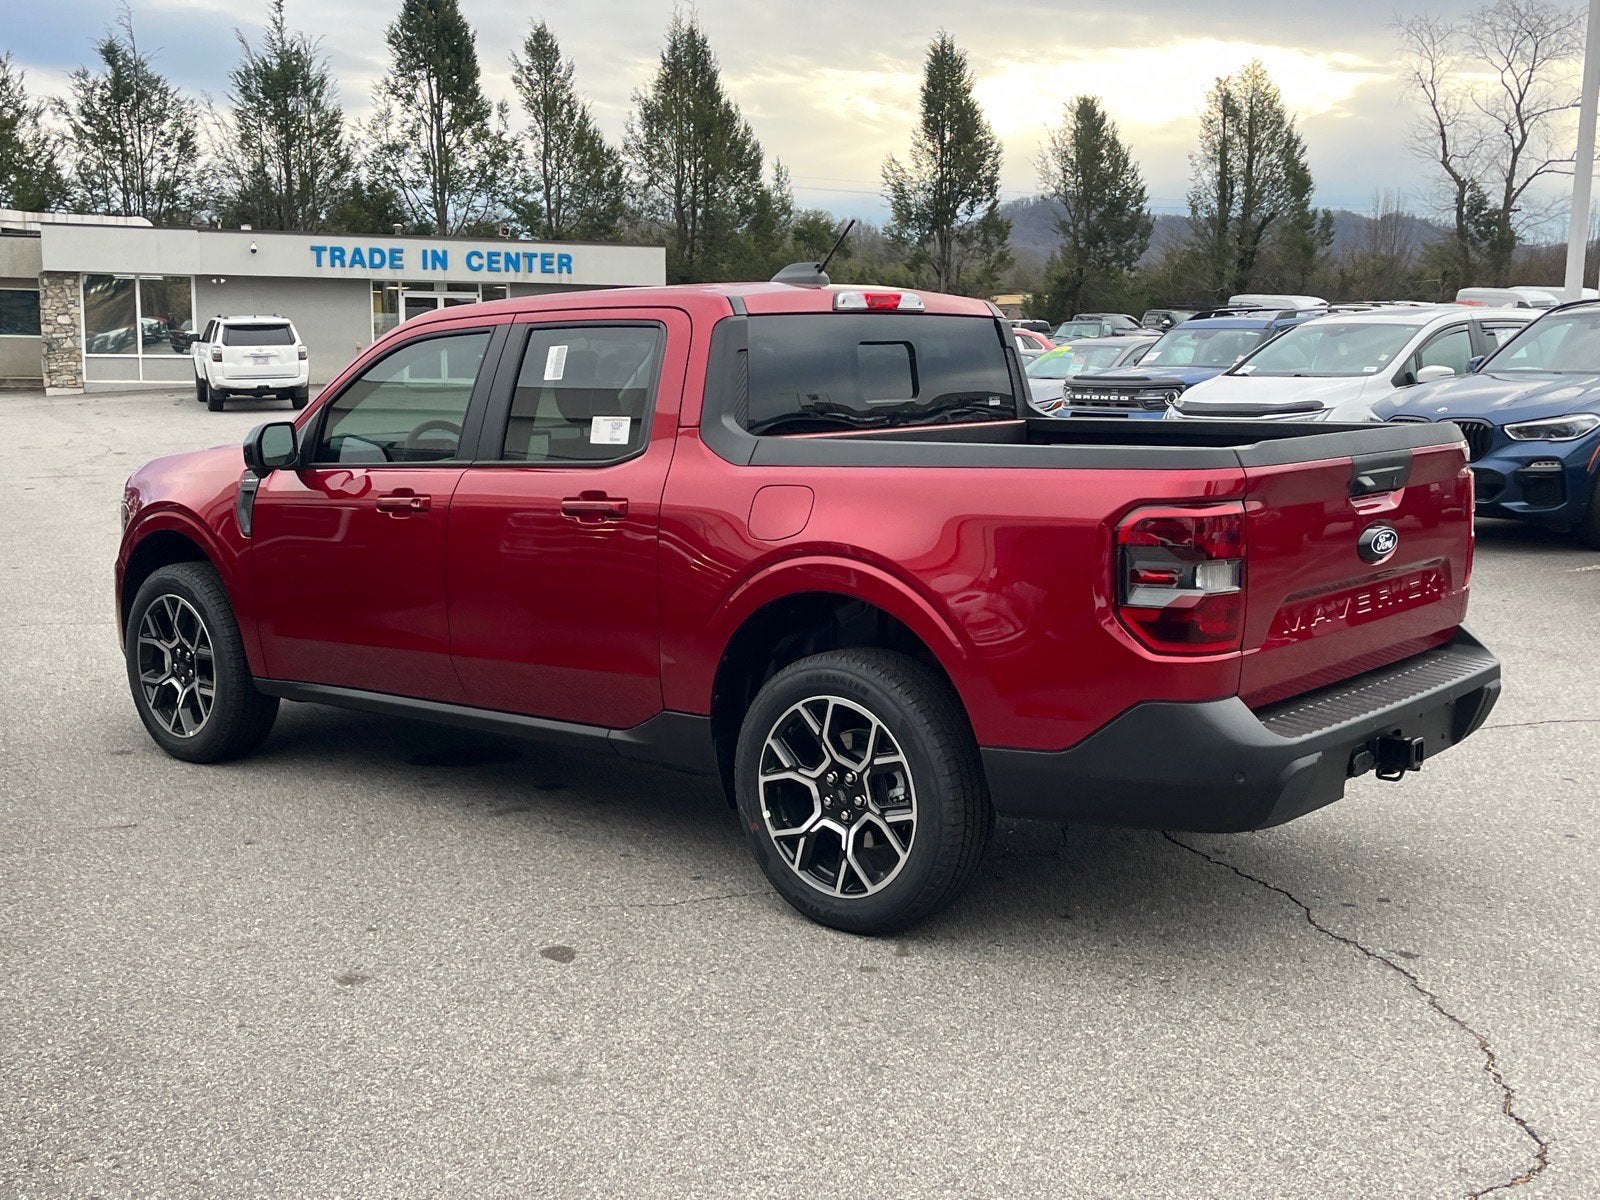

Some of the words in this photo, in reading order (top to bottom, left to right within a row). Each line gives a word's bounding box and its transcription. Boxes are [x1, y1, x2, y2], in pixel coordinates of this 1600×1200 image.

[310, 245, 404, 270] TRADE
[422, 249, 448, 271] IN
[465, 250, 573, 274] CENTER
[1074, 394, 1130, 402] BRONCO
[1375, 532, 1396, 552] Ford
[1282, 571, 1440, 635] MAVERICK
